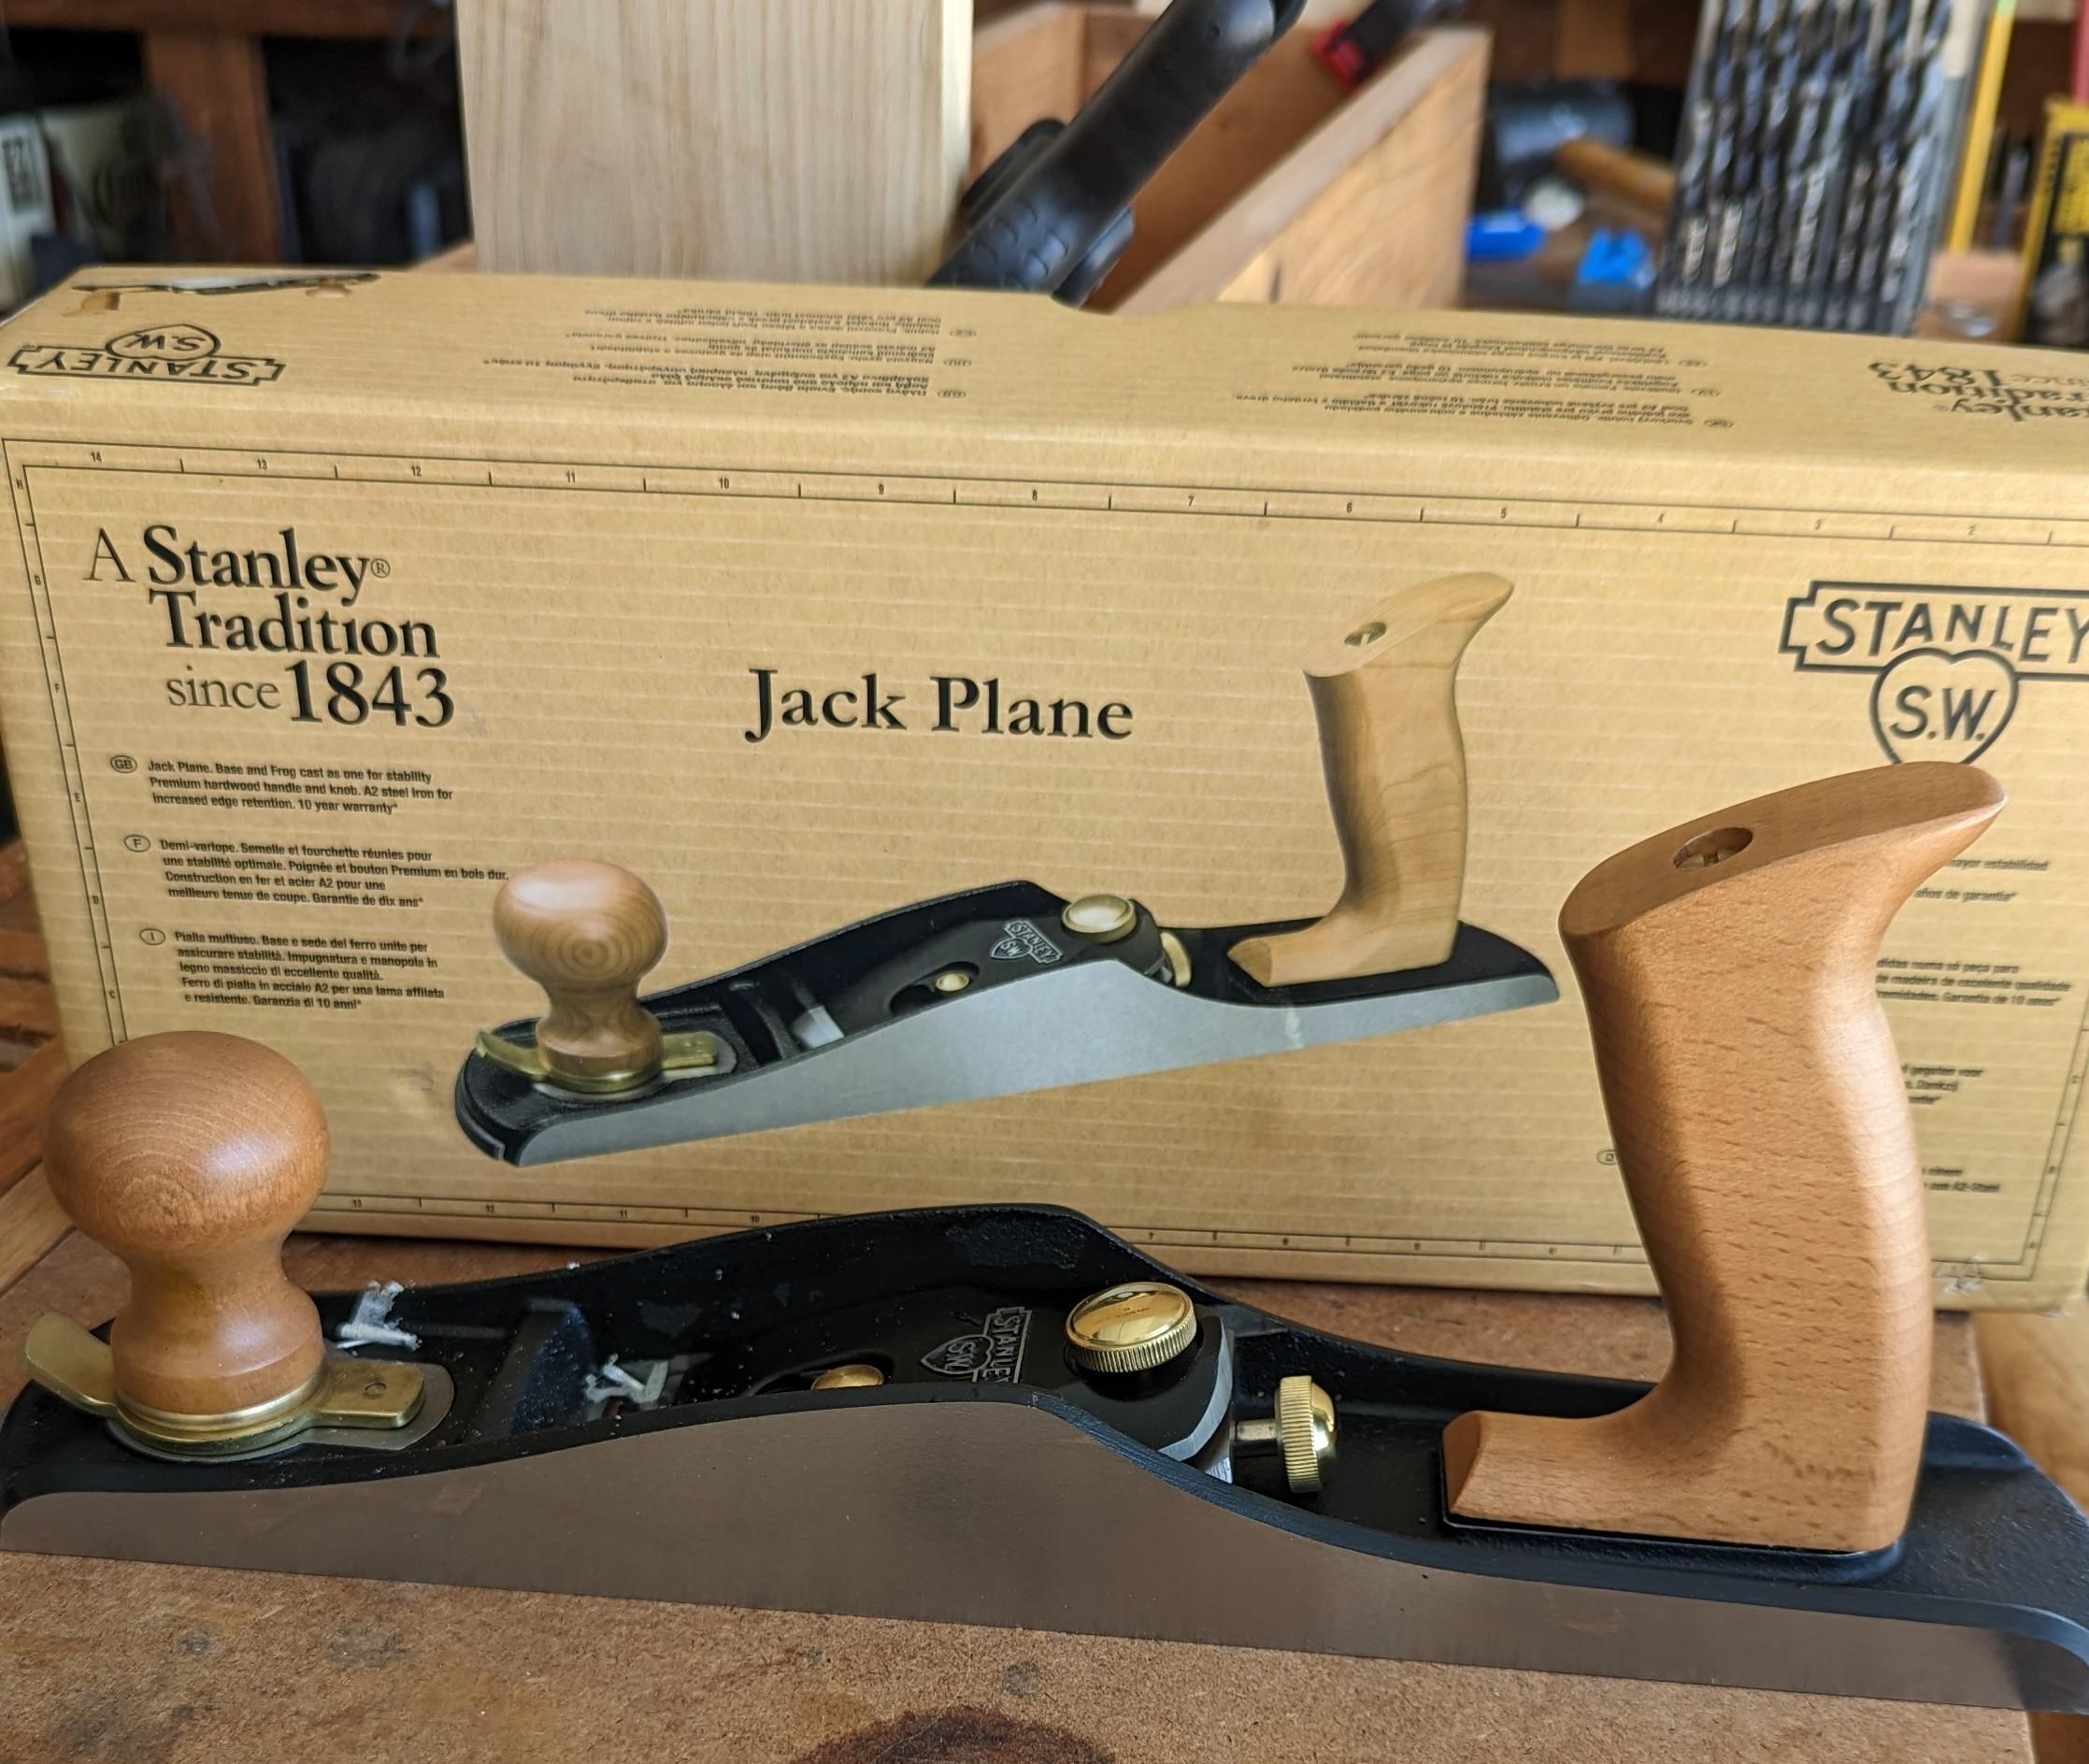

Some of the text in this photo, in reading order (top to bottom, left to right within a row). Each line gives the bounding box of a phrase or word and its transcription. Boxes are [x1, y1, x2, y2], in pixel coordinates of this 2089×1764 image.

[36, 350, 259, 380] STANLEY
[1867, 361, 2003, 387] 1843
[1888, 381, 2089, 408] radition
[256, 458, 268, 471] 13
[411, 464, 422, 477] 12
[565, 469, 576, 483] 11
[719, 476, 730, 490] 10
[82, 526, 136, 583] A
[149, 588, 441, 658] Tradition
[1815, 597, 2089, 664] STANLEY
[165, 658, 455, 728] since 1843
[744, 666, 1134, 744] Jack Plane
[1889, 684, 1997, 741] S.W.
[114, 758, 134, 771] GB
